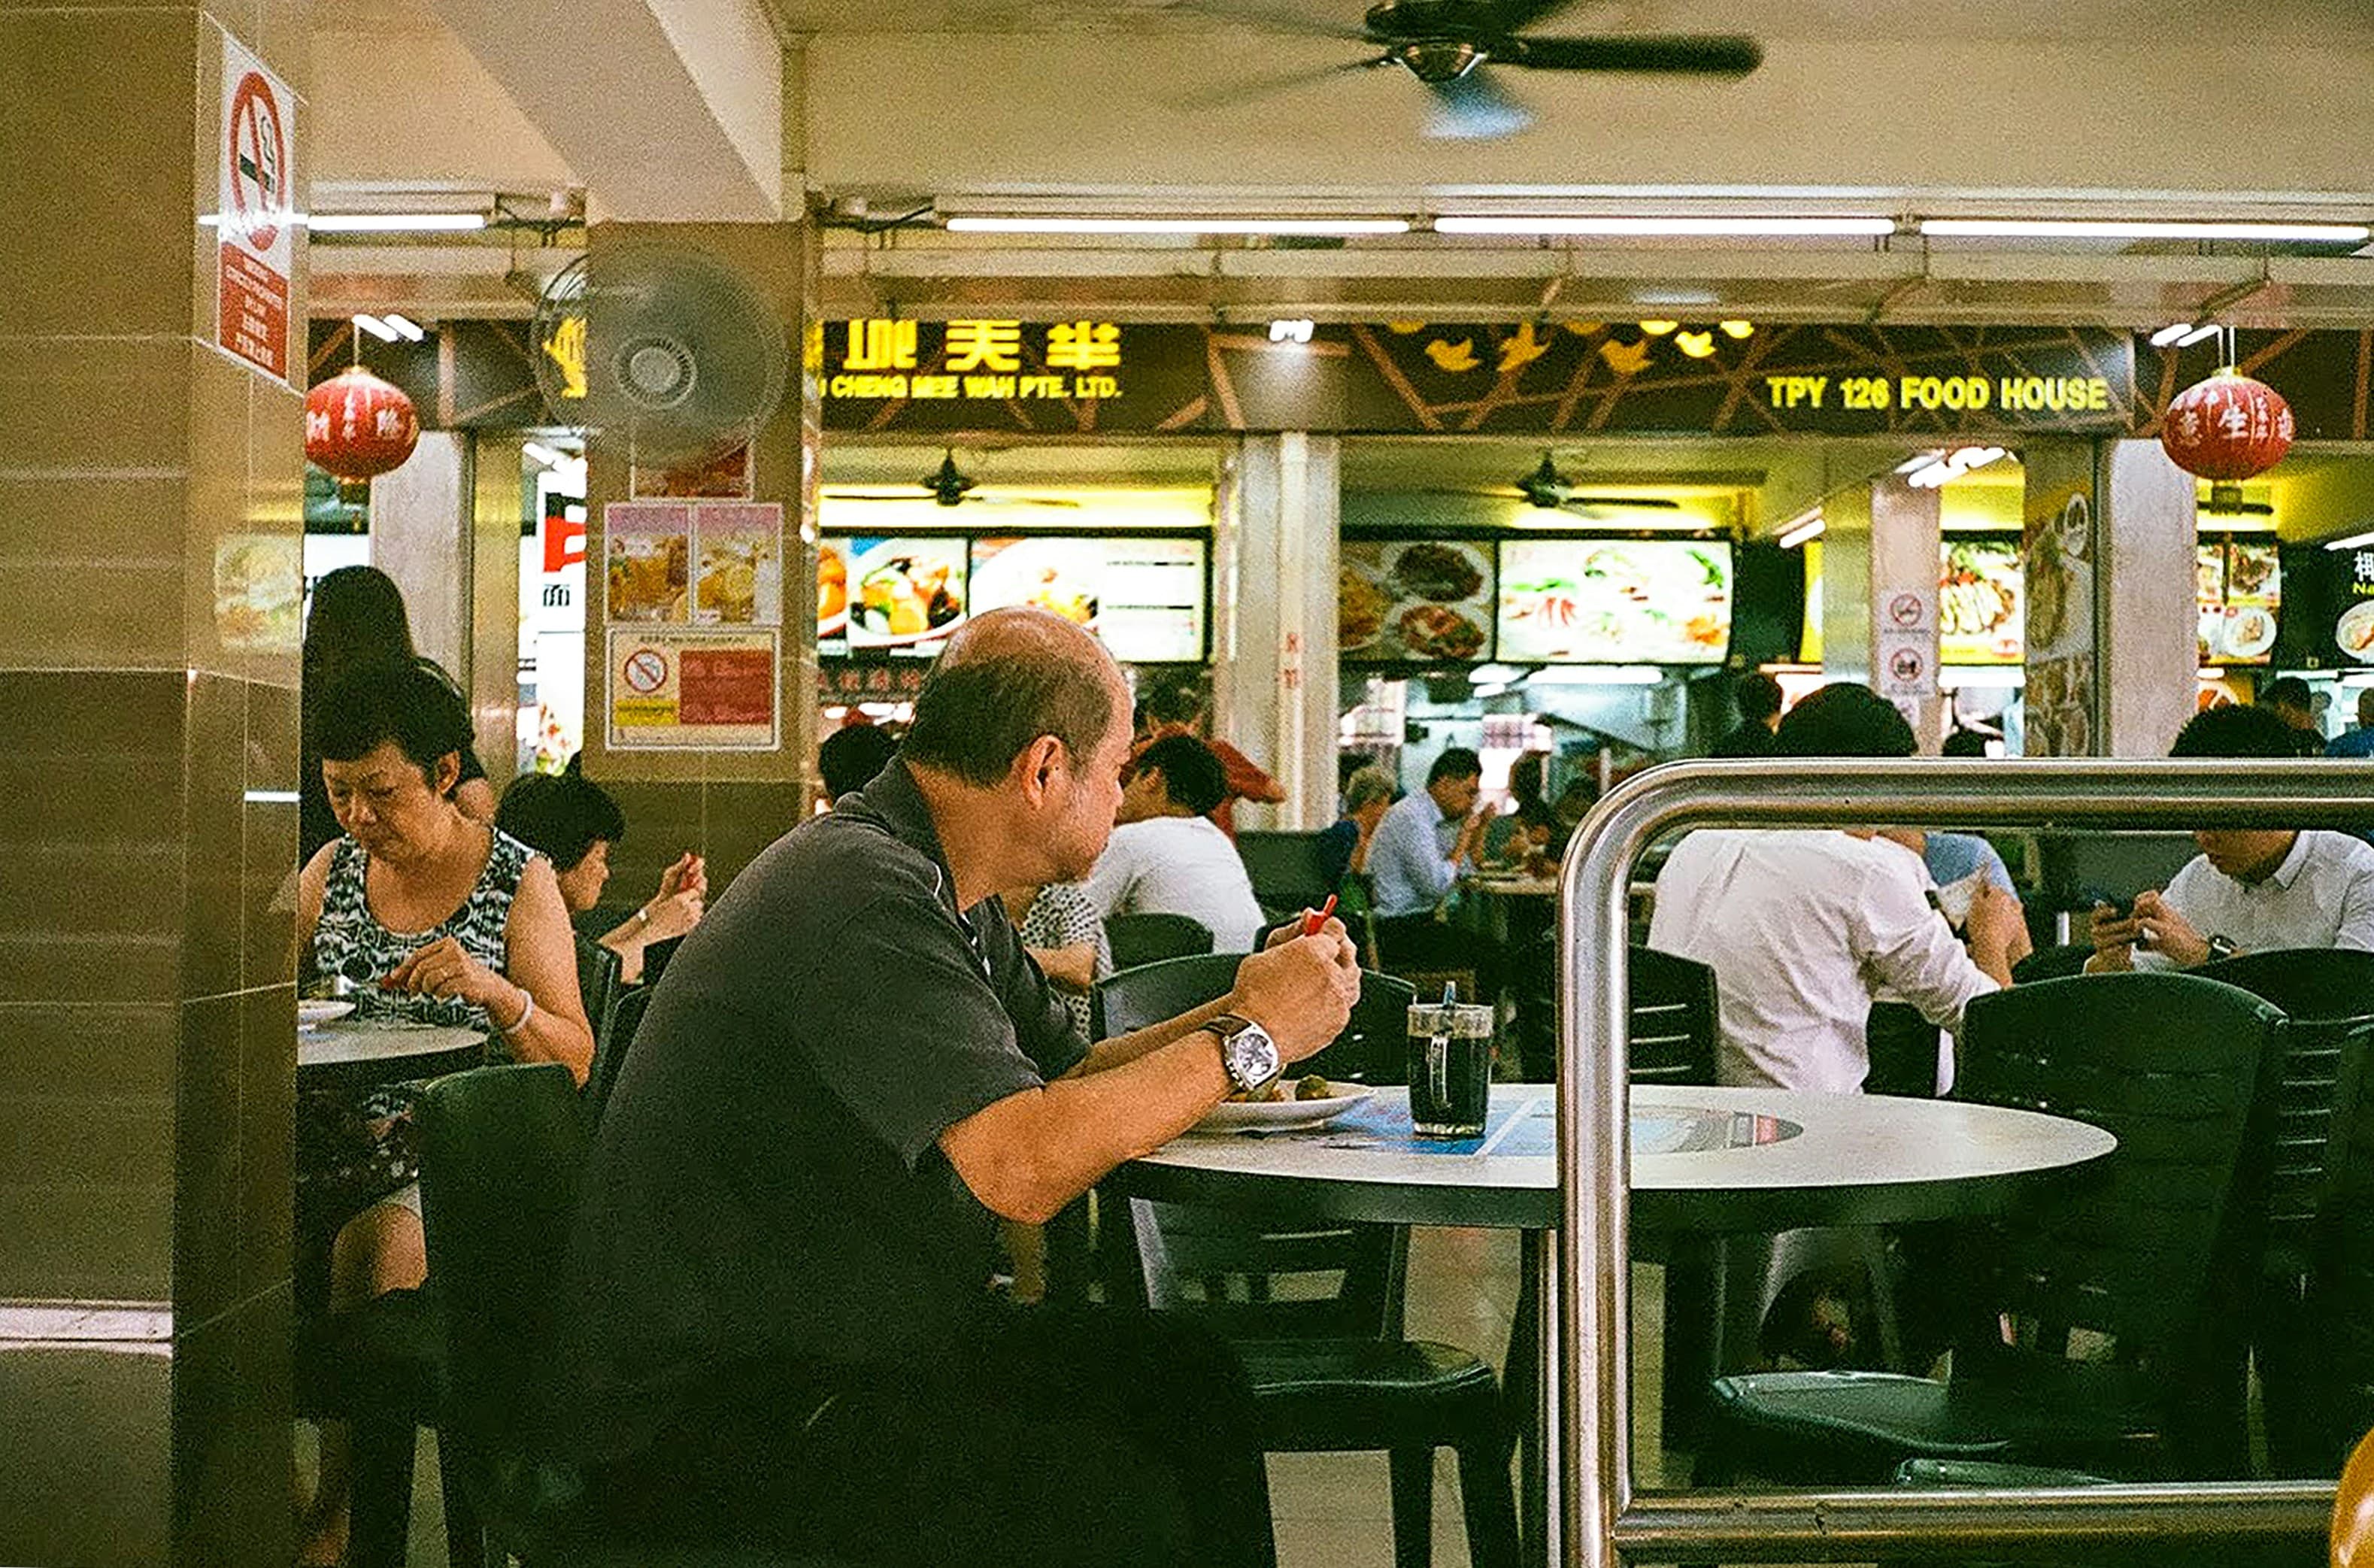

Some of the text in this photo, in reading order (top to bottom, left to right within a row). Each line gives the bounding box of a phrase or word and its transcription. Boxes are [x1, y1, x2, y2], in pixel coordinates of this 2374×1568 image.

[831, 375, 907, 398] CHENG
[1019, 376, 1072, 399] PTE.
[1075, 375, 1123, 399] LTD.
[1767, 376, 2109, 410] TPY 126 FOOD HOUSE
